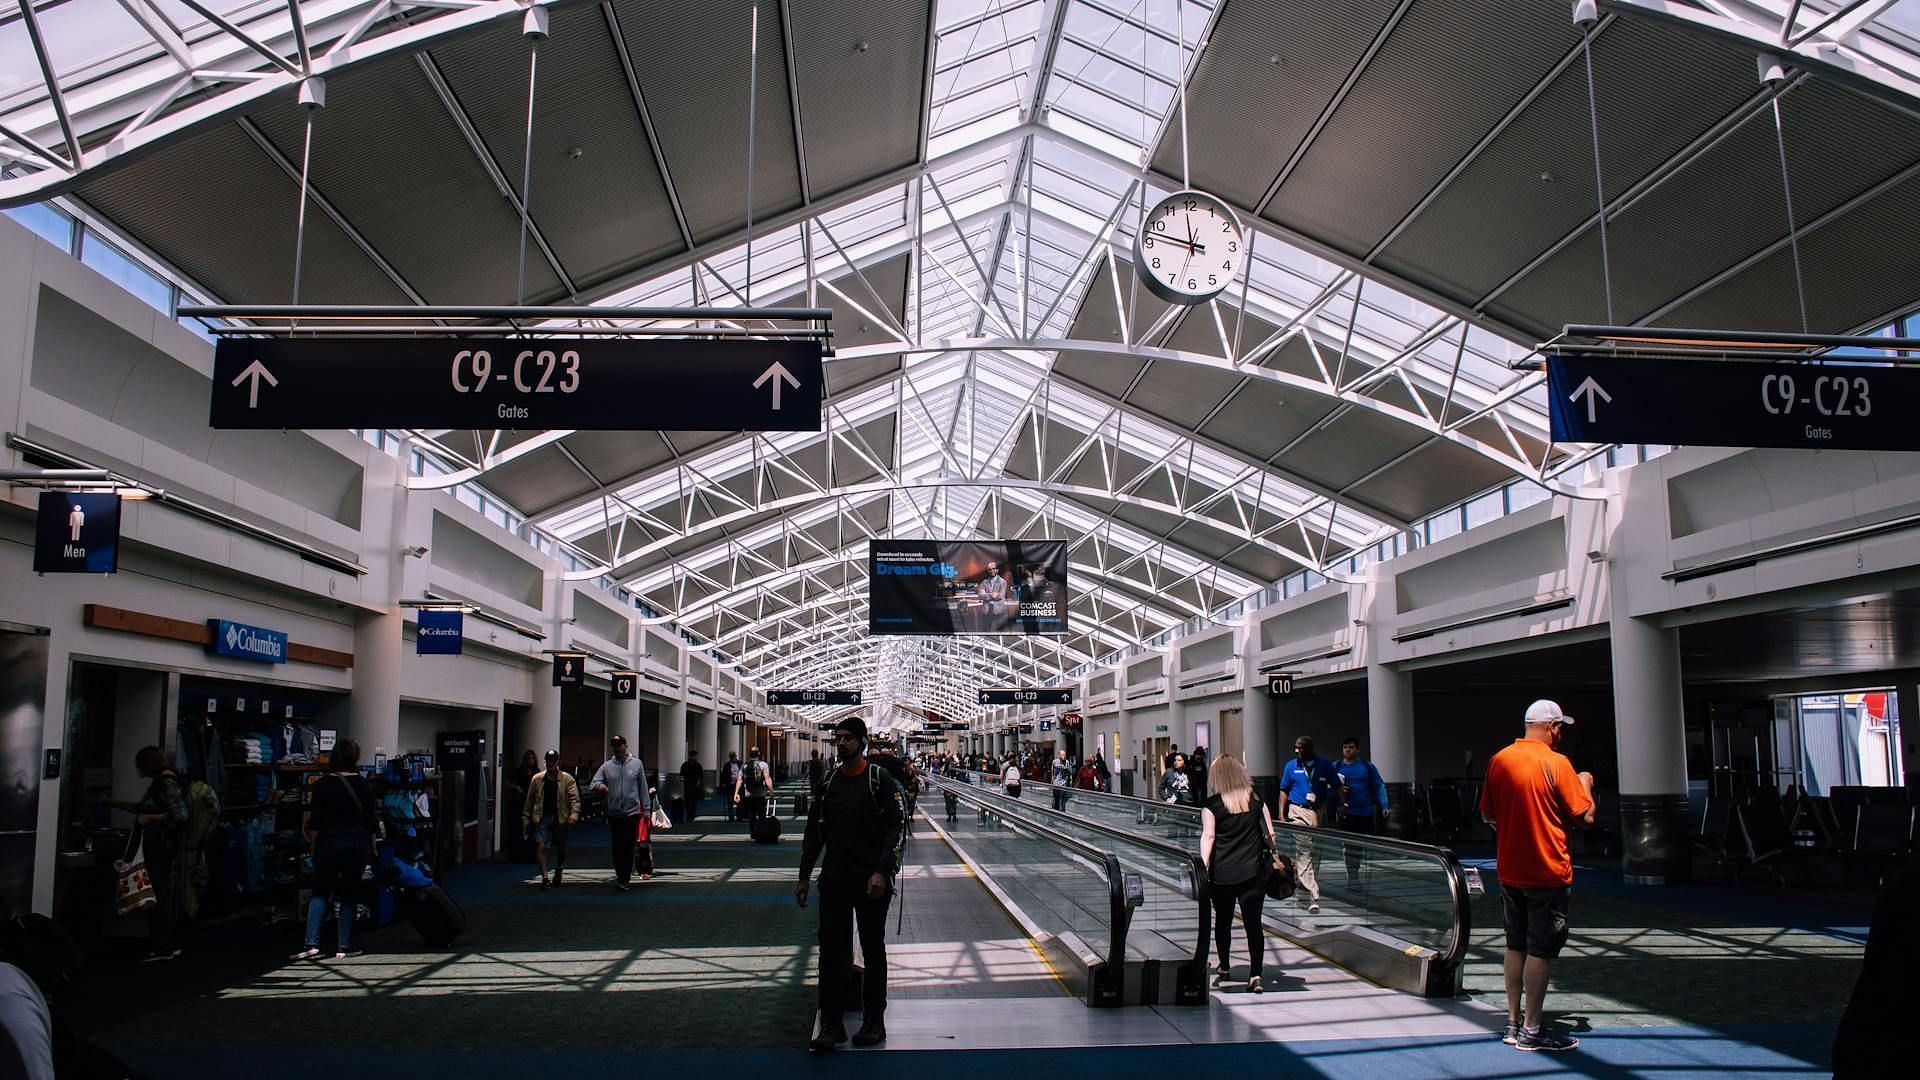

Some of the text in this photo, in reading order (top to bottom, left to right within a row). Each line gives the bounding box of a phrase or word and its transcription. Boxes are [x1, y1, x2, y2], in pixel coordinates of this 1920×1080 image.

[1164, 206, 1175, 216] 11
[1184, 200, 1197, 212] 12
[1208, 207, 1214, 218] 1
[1151, 221, 1165, 231] 10
[1222, 222, 1231, 232] 2
[1145, 238, 1154, 249] 9
[1228, 241, 1237, 252] 3
[1152, 257, 1161, 269] 8
[1222, 260, 1231, 271] 4
[1168, 273, 1176, 284] 7
[1188, 278, 1197, 290] 6
[1208, 274, 1217, 285] 5
[451, 350, 581, 394] C9-C23
[1761, 374, 1872, 417] C9-C23
[497, 403, 529, 419] Gates
[1805, 424, 1833, 440] Gates
[64, 544, 85, 558] Men
[876, 561, 959, 579] Dream Gig.
[1020, 602, 1056, 610] COMCAST
[1020, 609, 1057, 617] BUSINESS
[426, 627, 459, 636] Columbia
[237, 628, 281, 657] Columbia
[617, 679, 631, 694] C9
[1271, 678, 1291, 694] C10
[802, 692, 826, 701] C11-C23
[1014, 691, 1038, 701] C11-C23
[734, 713, 744, 723] C11
